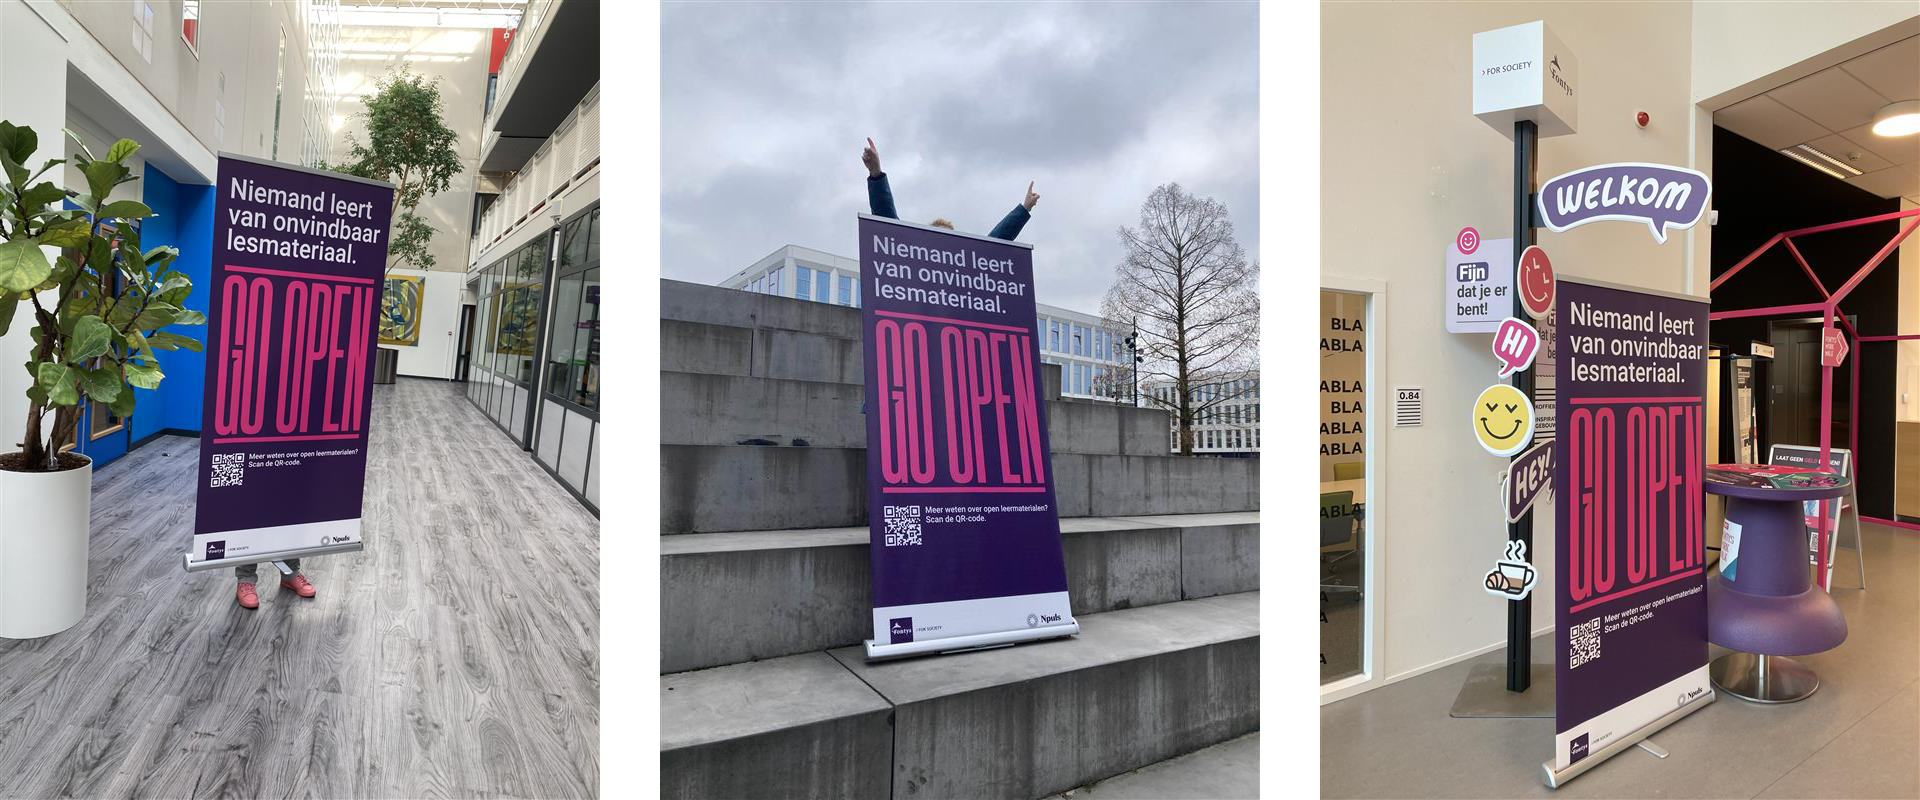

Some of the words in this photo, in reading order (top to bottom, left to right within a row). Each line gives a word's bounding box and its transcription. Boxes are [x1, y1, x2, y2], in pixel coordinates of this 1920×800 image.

[1486, 66, 1500, 76] FOR
[1502, 61, 1532, 73] SOCIETY
[1551, 69, 1573, 96] Fontys
[230, 177, 325, 212] Niemand
[330, 193, 372, 220] leert
[1556, 175, 1692, 216] WELKOM
[228, 208, 266, 229] van
[273, 216, 380, 244] onvindbaar
[227, 228, 356, 264] lesmateriaal.
[873, 235, 966, 267] Niemand
[972, 251, 1015, 275] leert
[873, 260, 912, 279] van
[918, 267, 1026, 296] onvindbaar
[1460, 264, 1485, 283] Fijn
[874, 278, 1007, 314] lesmateriaal.
[1457, 285, 1477, 298] dat
[1479, 284, 1491, 300] je
[1494, 286, 1507, 296] er
[1457, 302, 1488, 316] bent!
[1570, 302, 1654, 333] Niemand
[1659, 312, 1694, 336] leert
[1331, 318, 1363, 331] BLA
[215, 274, 274, 436] GO
[276, 280, 374, 434] OPEN
[1501, 326, 1528, 358] HI
[1570, 335, 1605, 355] van
[1610, 336, 1702, 360] onvindbaar
[1571, 357, 1685, 383] lesmateriaal.
[876, 319, 936, 485] GO
[940, 326, 1045, 484] OPEN
[1331, 401, 1363, 413] BLA
[1399, 392, 1420, 400] 0.84
[1516, 447, 1551, 504] HEY!
[984, 506, 999, 514] open
[1570, 407, 1615, 601] GO
[1626, 405, 1703, 584] OPEN
[925, 516, 943, 524] Scan
[955, 515, 986, 524] QR-code.
[1604, 612, 1620, 623] Meer
[1621, 607, 1638, 618] weten
[1640, 603, 1652, 612] over
[1652, 598, 1666, 608] open
[1666, 584, 1703, 602] leermaterialen?
[1040, 613, 1062, 624] Npuls
[1604, 623, 1620, 633] Scan
[1620, 620, 1628, 628] de
[1629, 611, 1654, 625] QR-code.
